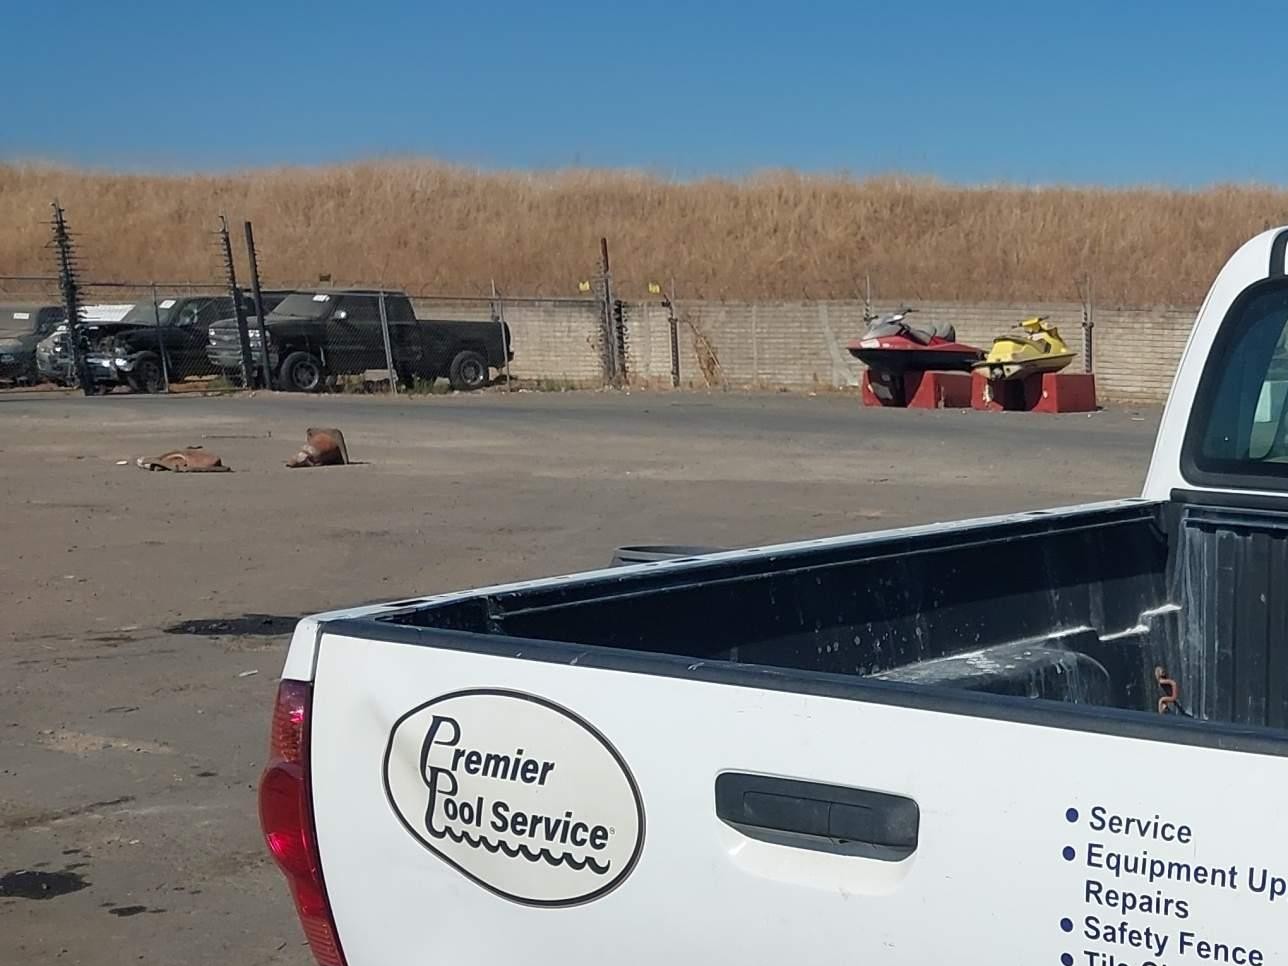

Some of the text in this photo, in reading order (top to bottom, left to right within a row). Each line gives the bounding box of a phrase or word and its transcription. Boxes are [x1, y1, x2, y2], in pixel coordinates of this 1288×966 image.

[419, 715, 555, 790] Premier
[425, 765, 485, 839] Pool
[1089, 806, 1193, 844] Service
[1086, 843, 1239, 890] Equipment
[1084, 879, 1190, 918] Repairs
[1083, 916, 1169, 956] Safety
